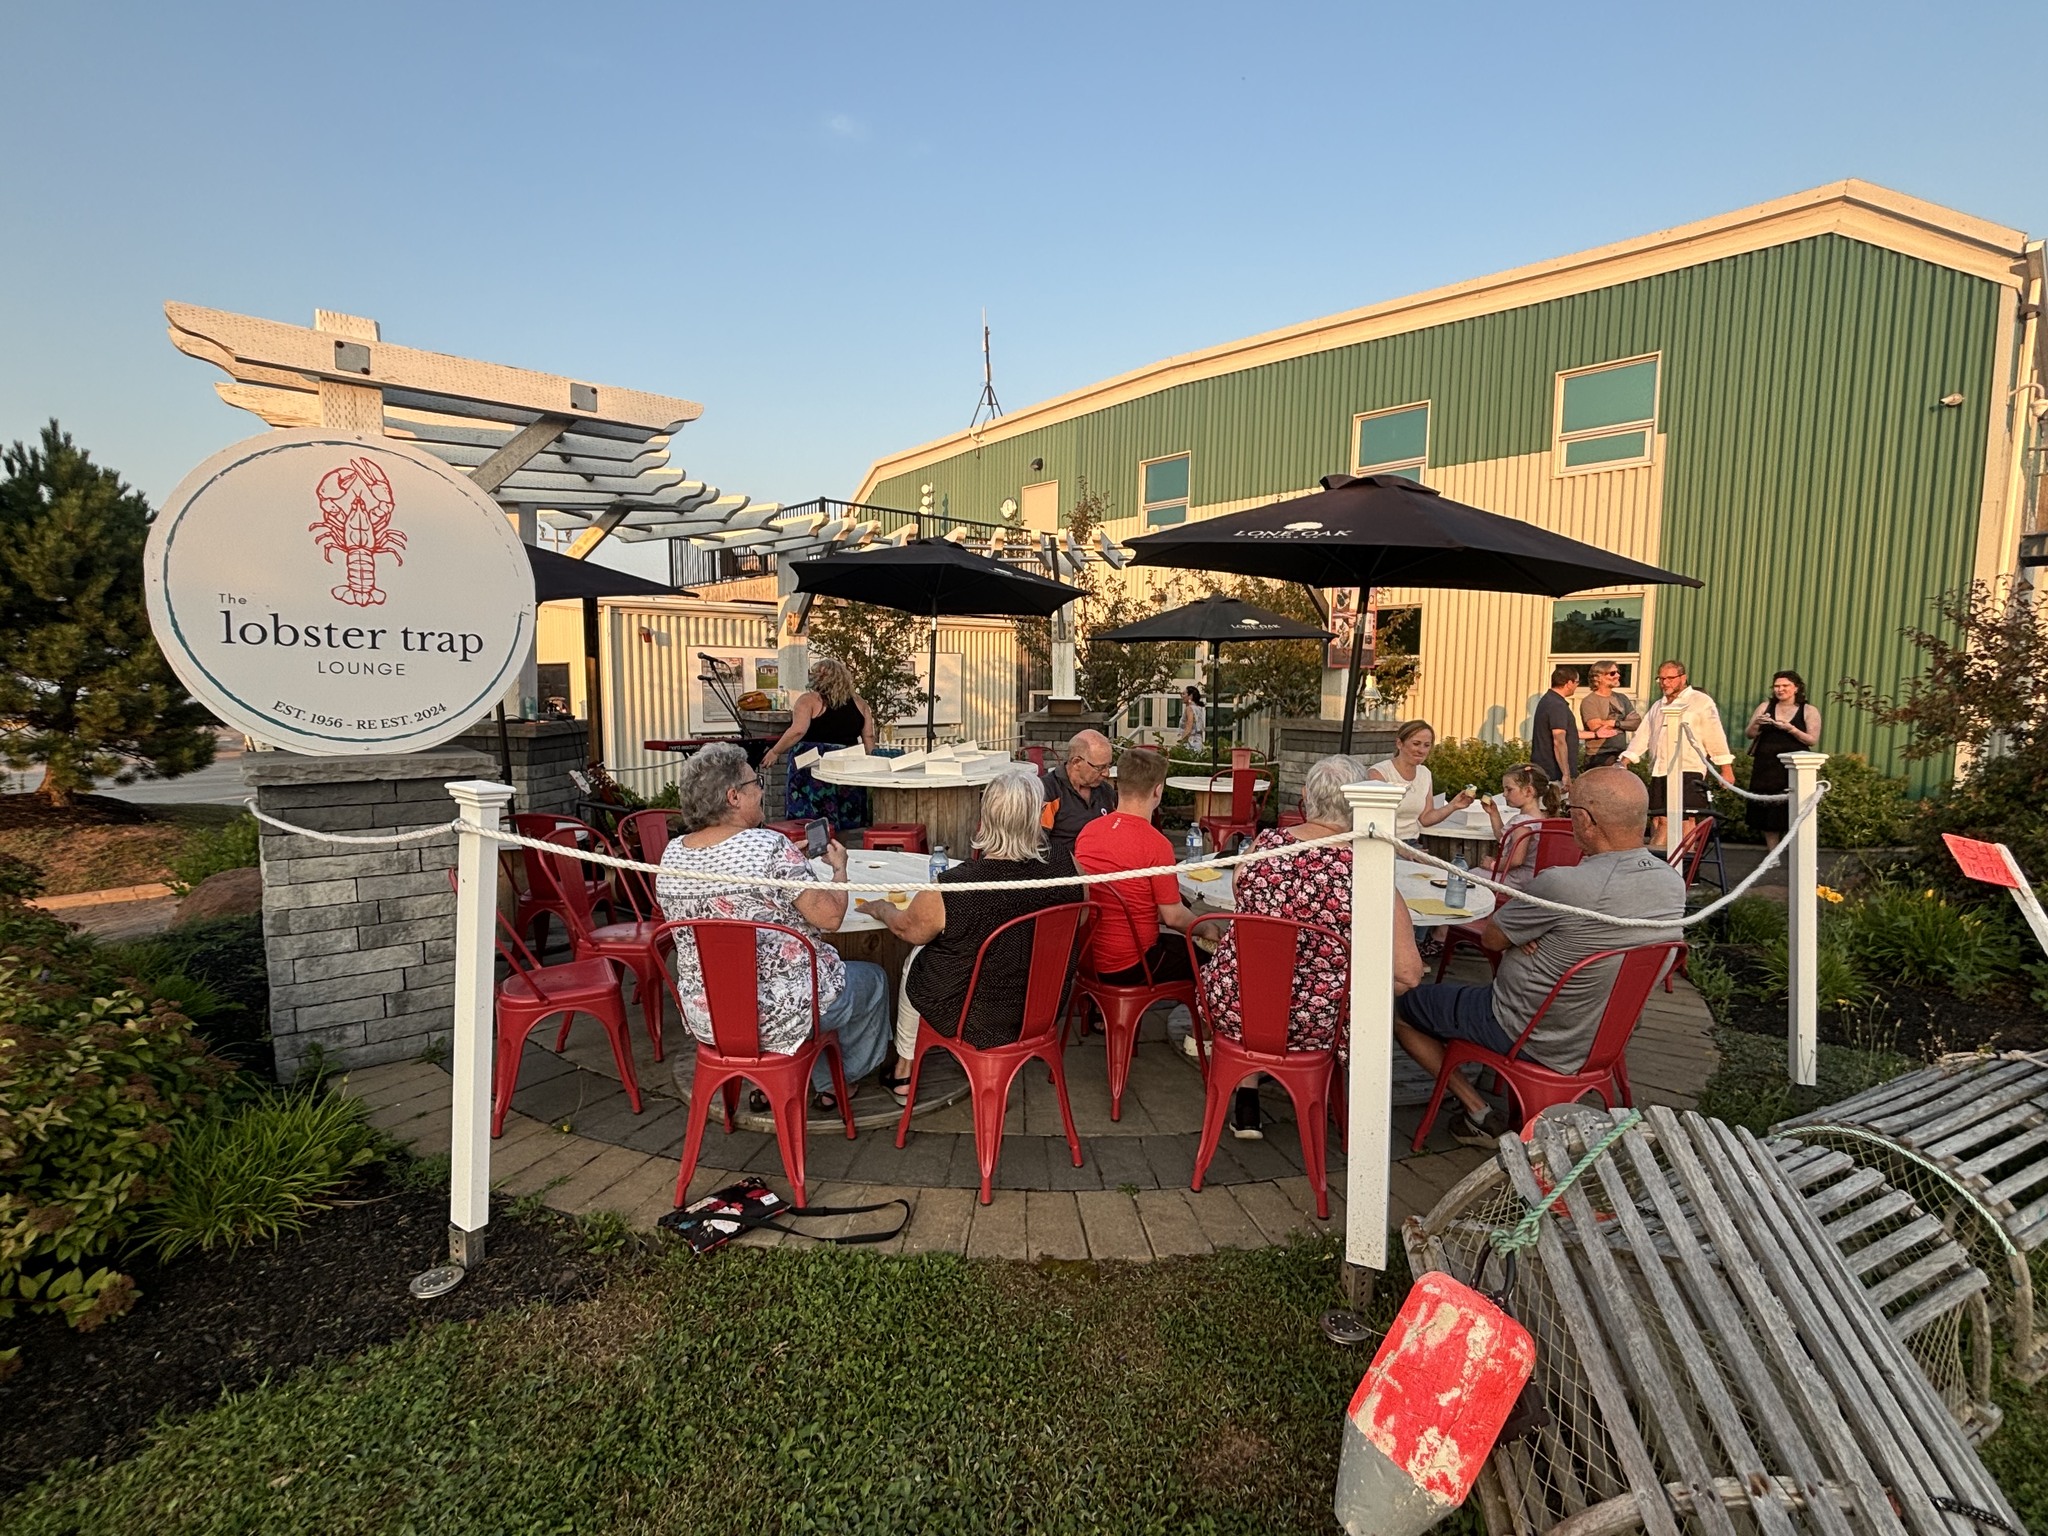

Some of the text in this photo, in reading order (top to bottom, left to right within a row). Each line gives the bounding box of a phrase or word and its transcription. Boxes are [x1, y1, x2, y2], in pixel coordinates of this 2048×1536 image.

[218, 593, 247, 605] The
[219, 610, 484, 662] lobster trap
[318, 661, 406, 676] LOUNGE
[272, 700, 306, 721] EST.
[310, 713, 343, 728] 1956
[356, 719, 377, 730] RE
[381, 715, 413, 729] EST.
[414, 702, 447, 722] 2024
